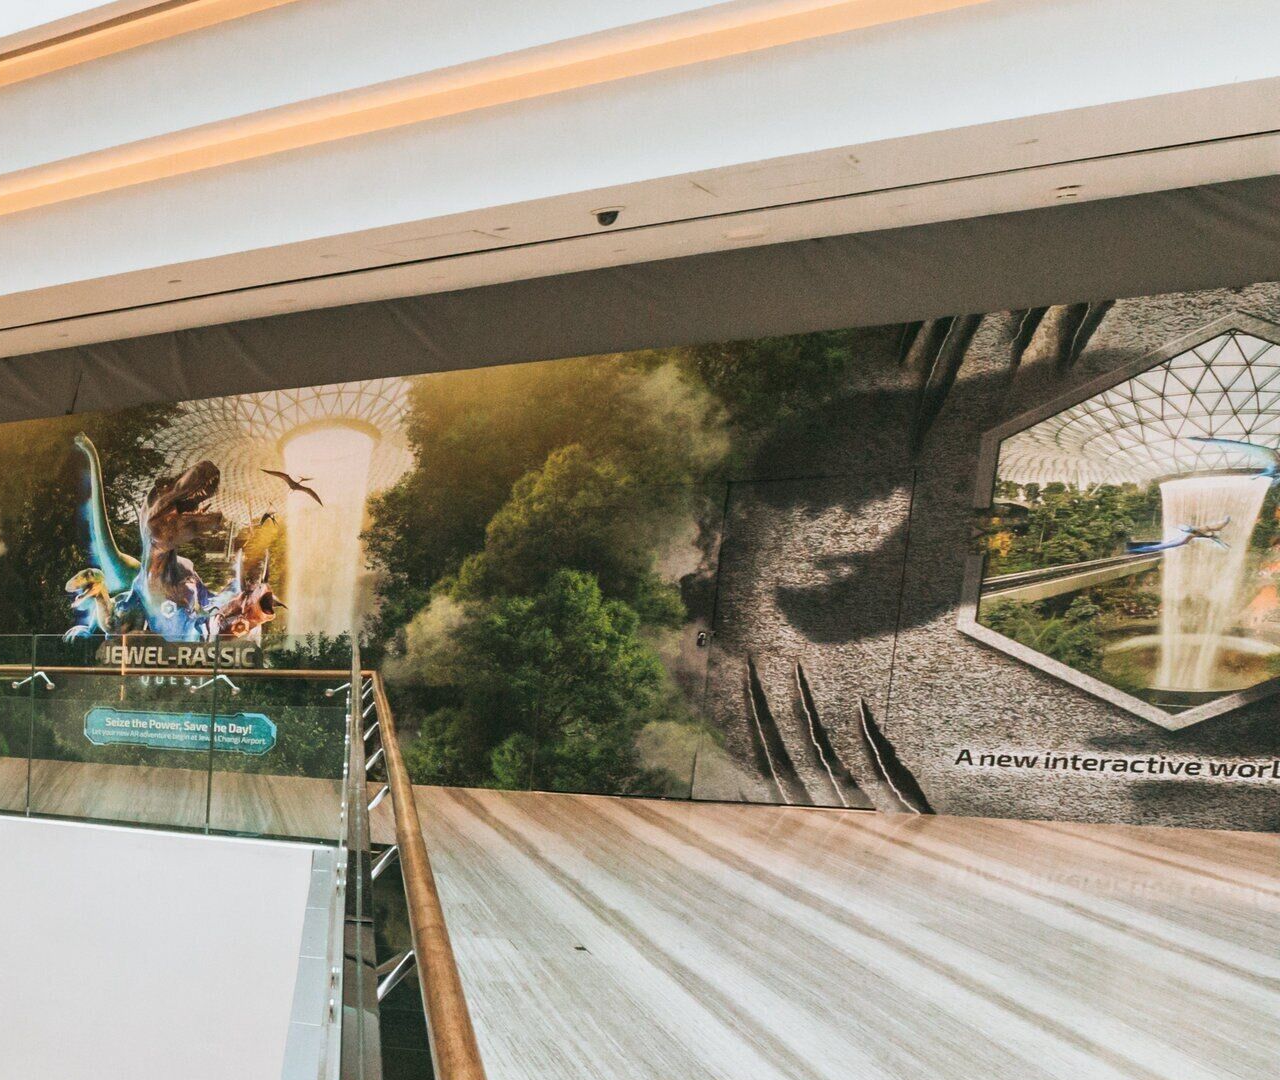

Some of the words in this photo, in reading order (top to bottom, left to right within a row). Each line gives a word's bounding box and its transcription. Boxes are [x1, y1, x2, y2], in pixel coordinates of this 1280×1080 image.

[103, 645, 256, 666] JEWEL-RASSIC
[141, 675, 206, 687] QUEST
[105, 717, 130, 728] Seize
[132, 718, 148, 729] the
[149, 719, 182, 732] Power,
[184, 721, 208, 732] Save
[228, 723, 252, 735] Day!
[139, 731, 171, 739] adventure
[172, 732, 190, 742] begin
[218, 735, 240, 744] Changi
[954, 749, 974, 766] A
[979, 752, 1037, 768] new
[1043, 751, 1202, 776] interactive
